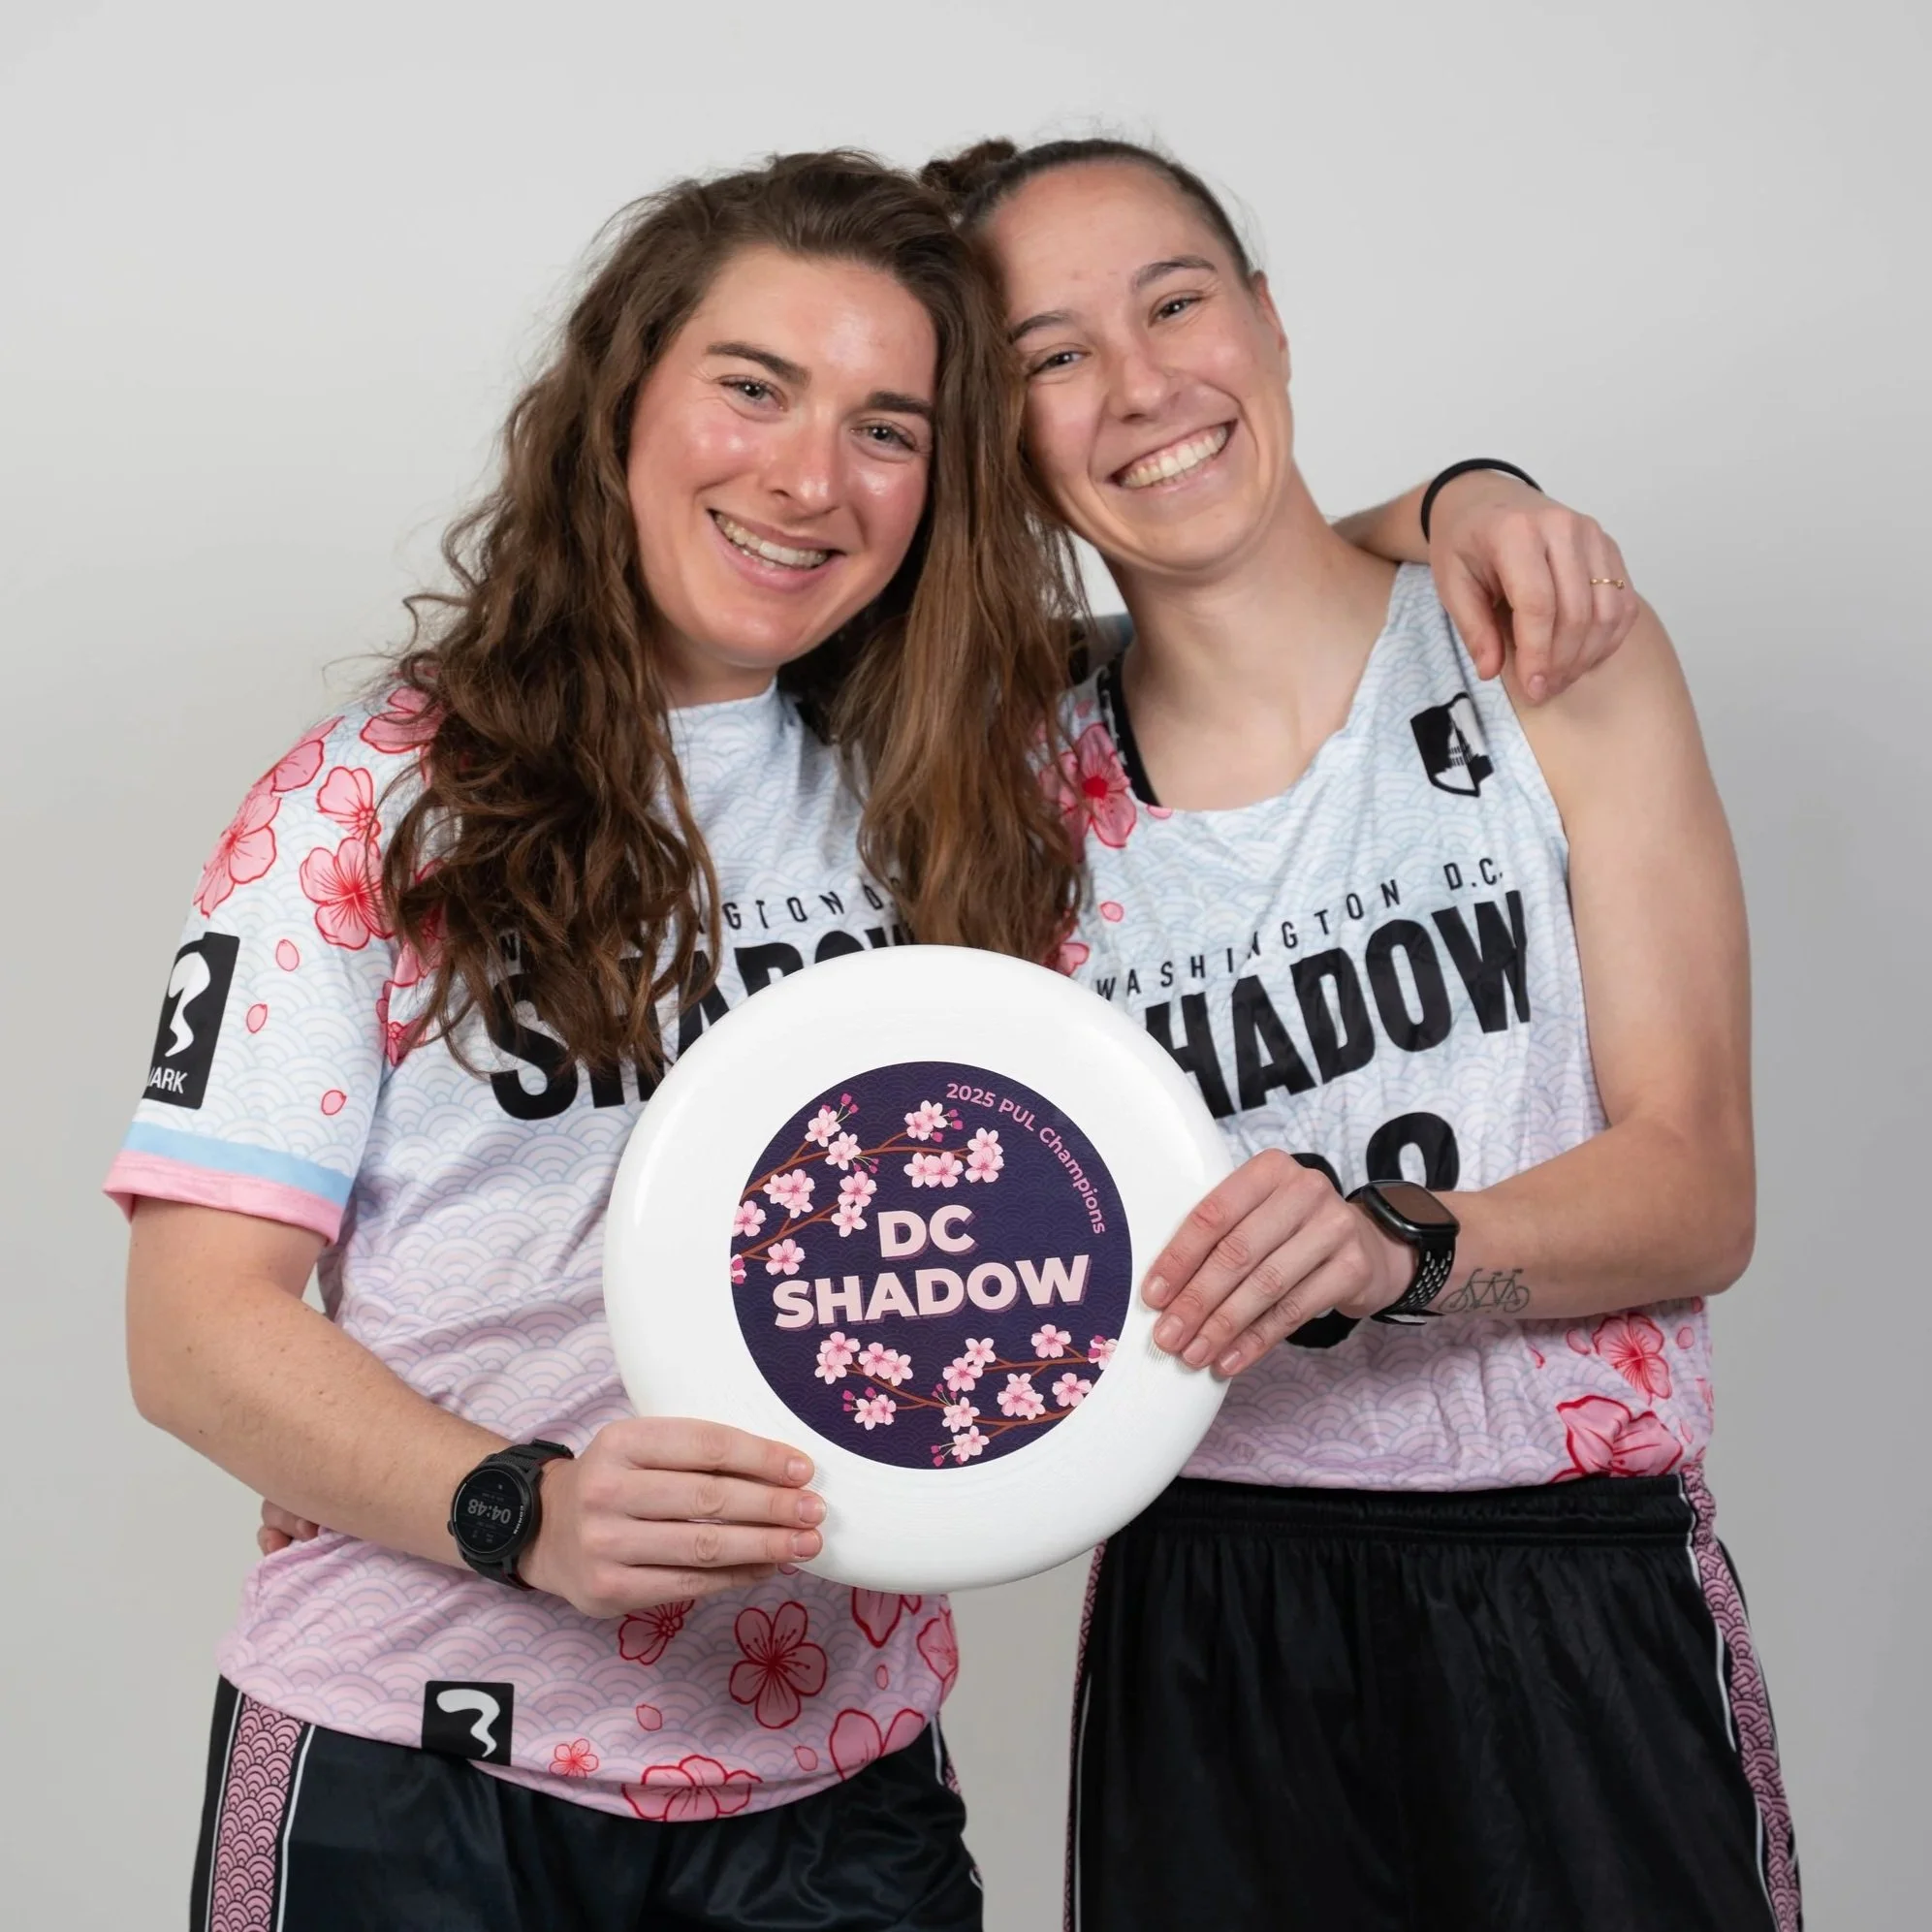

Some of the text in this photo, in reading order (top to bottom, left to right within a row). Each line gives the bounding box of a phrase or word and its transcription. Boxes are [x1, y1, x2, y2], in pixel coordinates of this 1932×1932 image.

[1443, 858, 1503, 890] D.C.
[1145, 889, 1531, 1120] HADOW
[148, 1065, 188, 1094] ARK
[947, 1083, 1106, 1235] 2025 PUL Champions
[877, 1204, 978, 1259] DC
[773, 1254, 1091, 1329] SHADOW
[467, 1499, 511, 1524] 04:48
